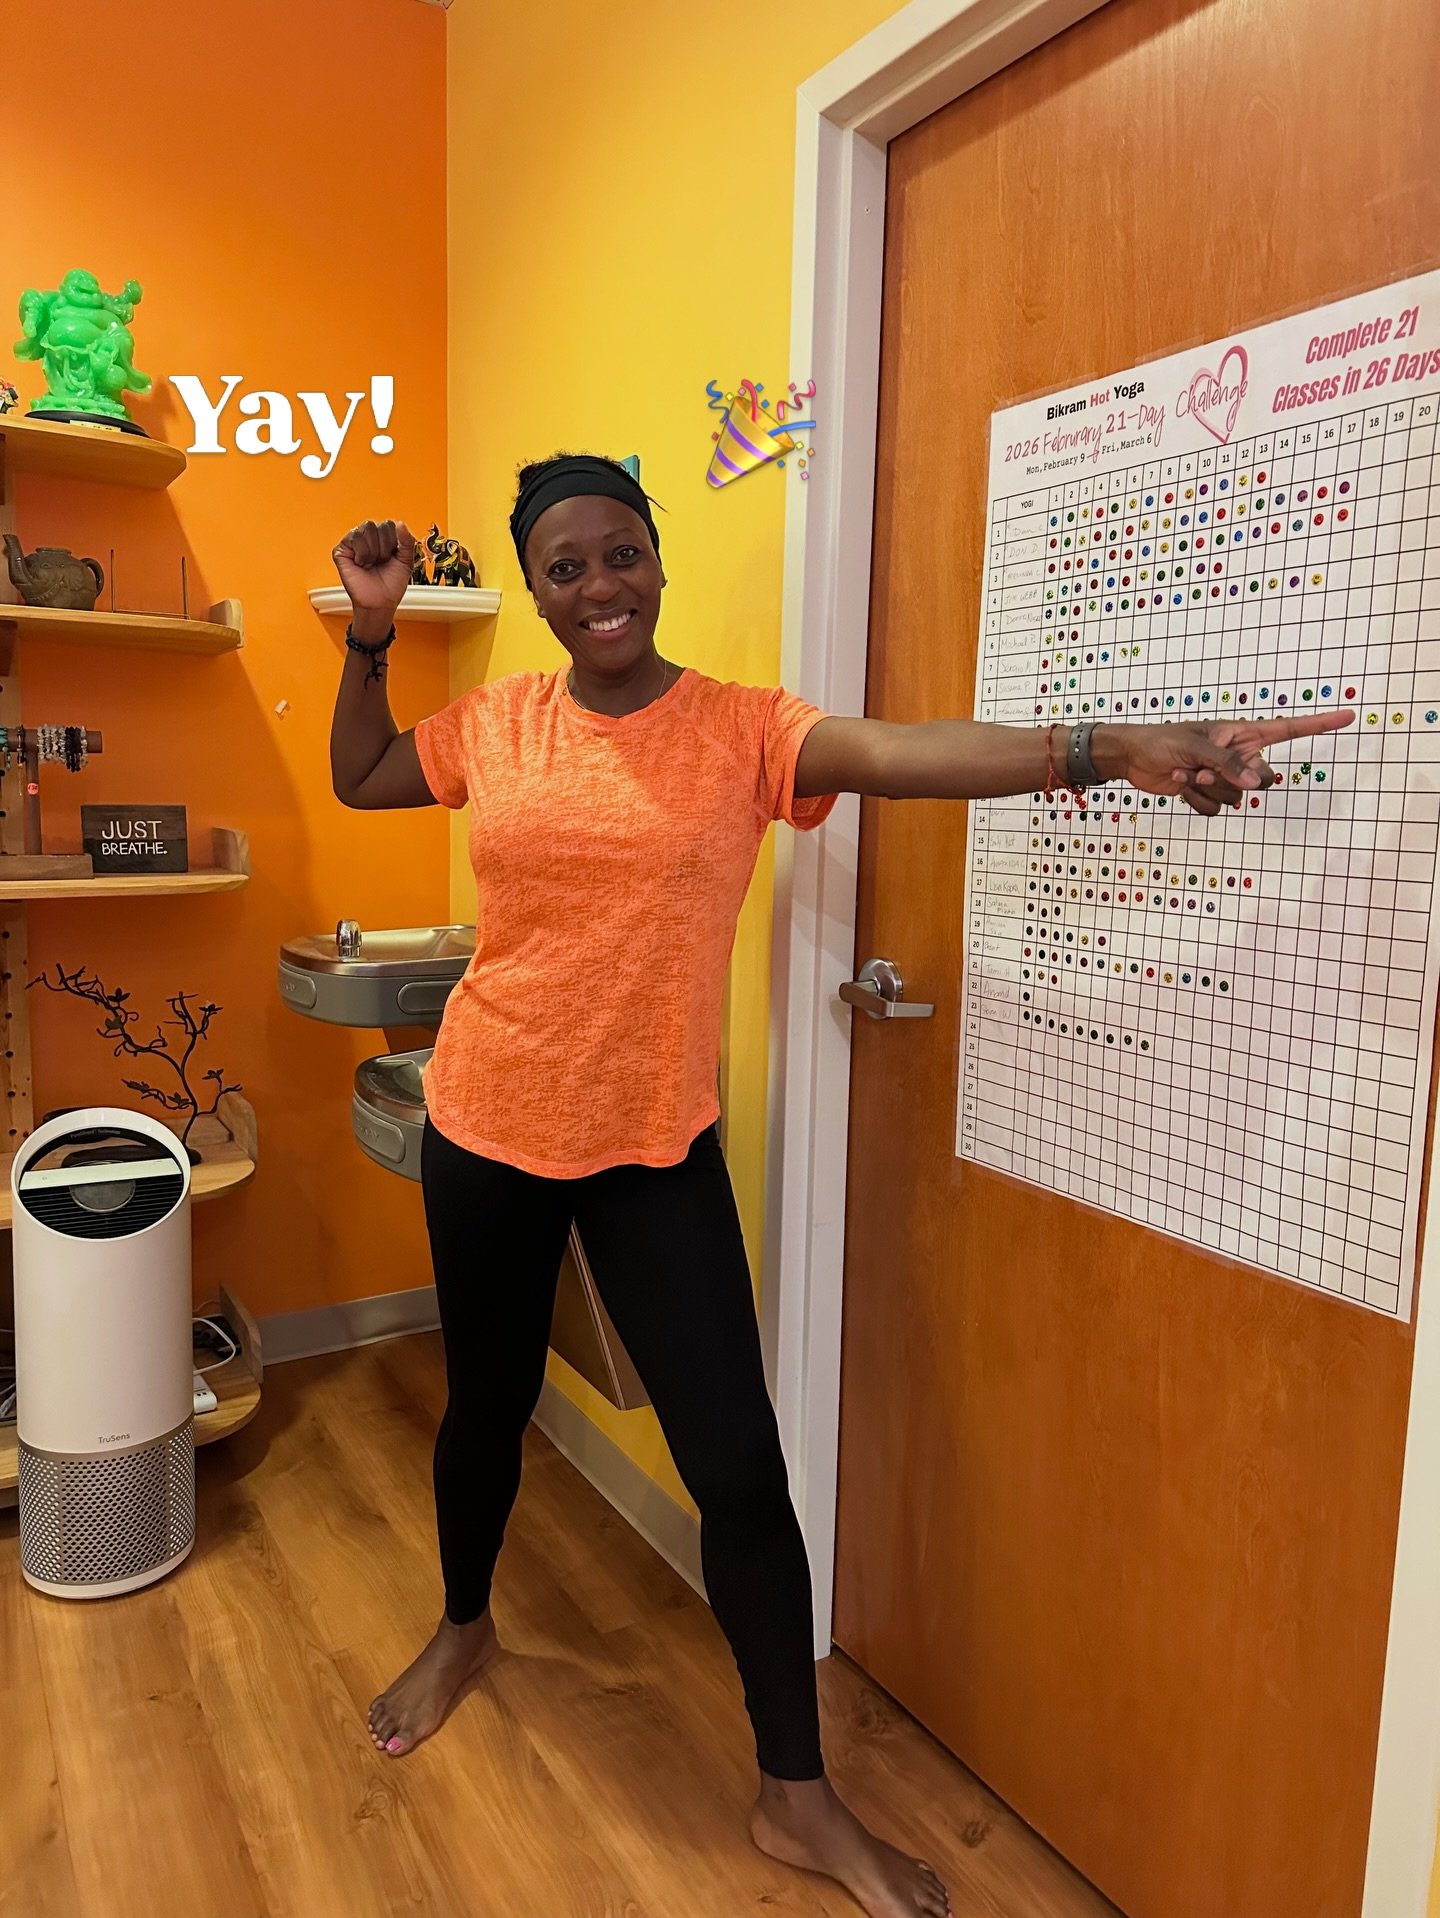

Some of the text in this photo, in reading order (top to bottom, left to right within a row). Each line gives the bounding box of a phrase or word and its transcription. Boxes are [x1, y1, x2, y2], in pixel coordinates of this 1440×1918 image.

[1306, 306, 1420, 364] Complete 21
[1047, 381, 1145, 420] Bikram Hot Yoga
[1272, 349, 1440, 414] Classes in 26 Days
[1004, 437, 1040, 463] 2026
[1106, 404, 1166, 448] 21-Day
[1176, 378, 1248, 432] Challenge
[1020, 500, 1034, 508] YOGI
[1202, 459, 1211, 468] 10
[1222, 454, 1230, 463] 11
[1241, 449, 1249, 458] 12
[1259, 444, 1268, 454] 13
[1279, 439, 1289, 448] 14
[1302, 434, 1311, 444] 15
[1324, 429, 1334, 439] 16
[1347, 423, 1356, 433] 17
[1369, 417, 1379, 428] 18
[1393, 412, 1404, 422] 19
[1419, 406, 1431, 417] 20
[1080, 454, 1085, 463] 9
[1146, 433, 1152, 444] 6
[102, 820, 162, 839] JUST
[102, 842, 167, 855] BREATHE.
[98, 1432, 130, 1444] TruSens
